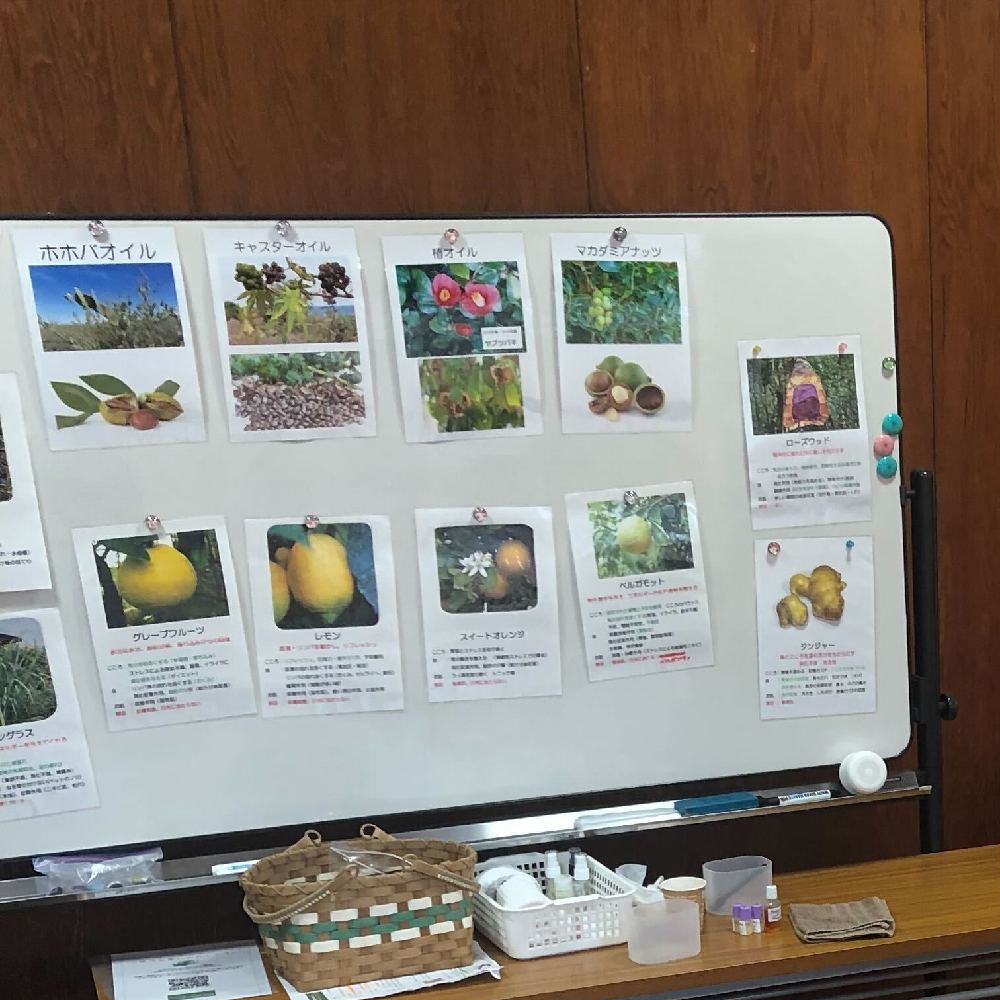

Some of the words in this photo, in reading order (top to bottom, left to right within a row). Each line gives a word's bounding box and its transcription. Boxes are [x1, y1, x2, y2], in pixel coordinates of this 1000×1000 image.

[40, 243, 156, 261] ホホバオイル
[234, 241, 331, 253] キャスターオイル
[576, 245, 661, 258] マカダミアナッツ
[619, 578, 665, 589] ベルガモット
[132, 626, 205, 642] グレープフルーツ
[314, 632, 340, 641] レモン
[459, 630, 525, 641] スイートオレンジ
